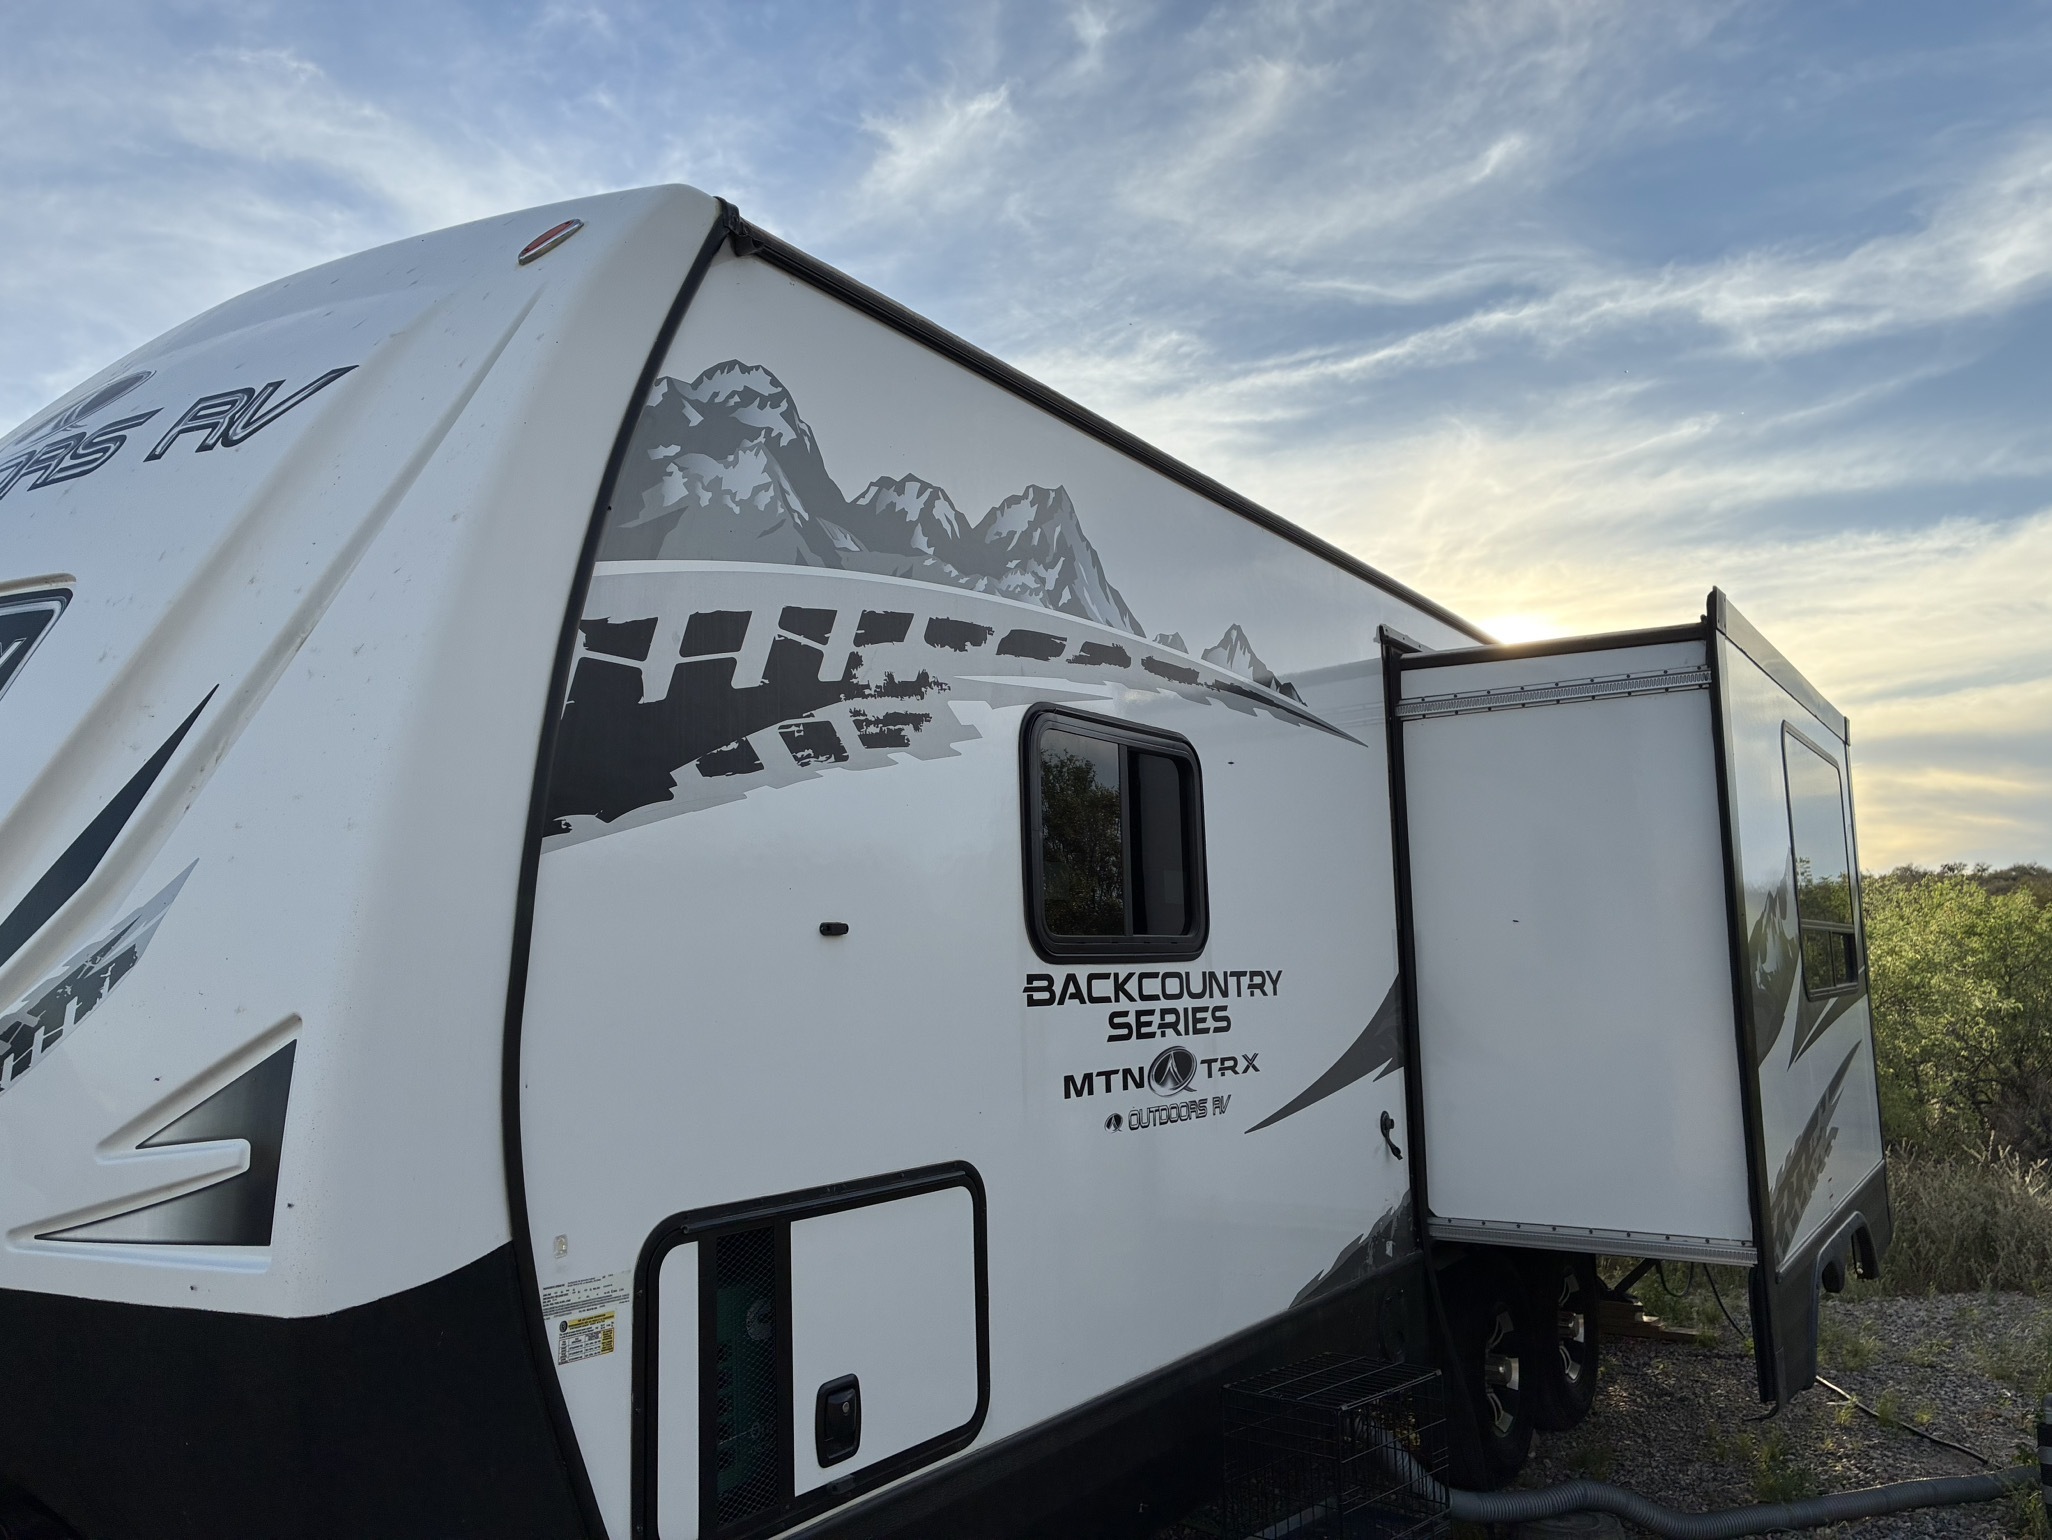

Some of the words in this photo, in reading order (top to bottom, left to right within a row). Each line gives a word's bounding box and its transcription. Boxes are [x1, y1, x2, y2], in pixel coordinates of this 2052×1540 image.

[143, 365, 359, 462] RV
[1023, 970, 1282, 1007] BACKCOUNTRY
[1107, 1005, 1231, 1042] SERIES
[1064, 1066, 1145, 1099] MTN
[1200, 1052, 1260, 1079] TRX
[1128, 1098, 1208, 1131] OUTDOORS
[1212, 1094, 1231, 1116] RV
